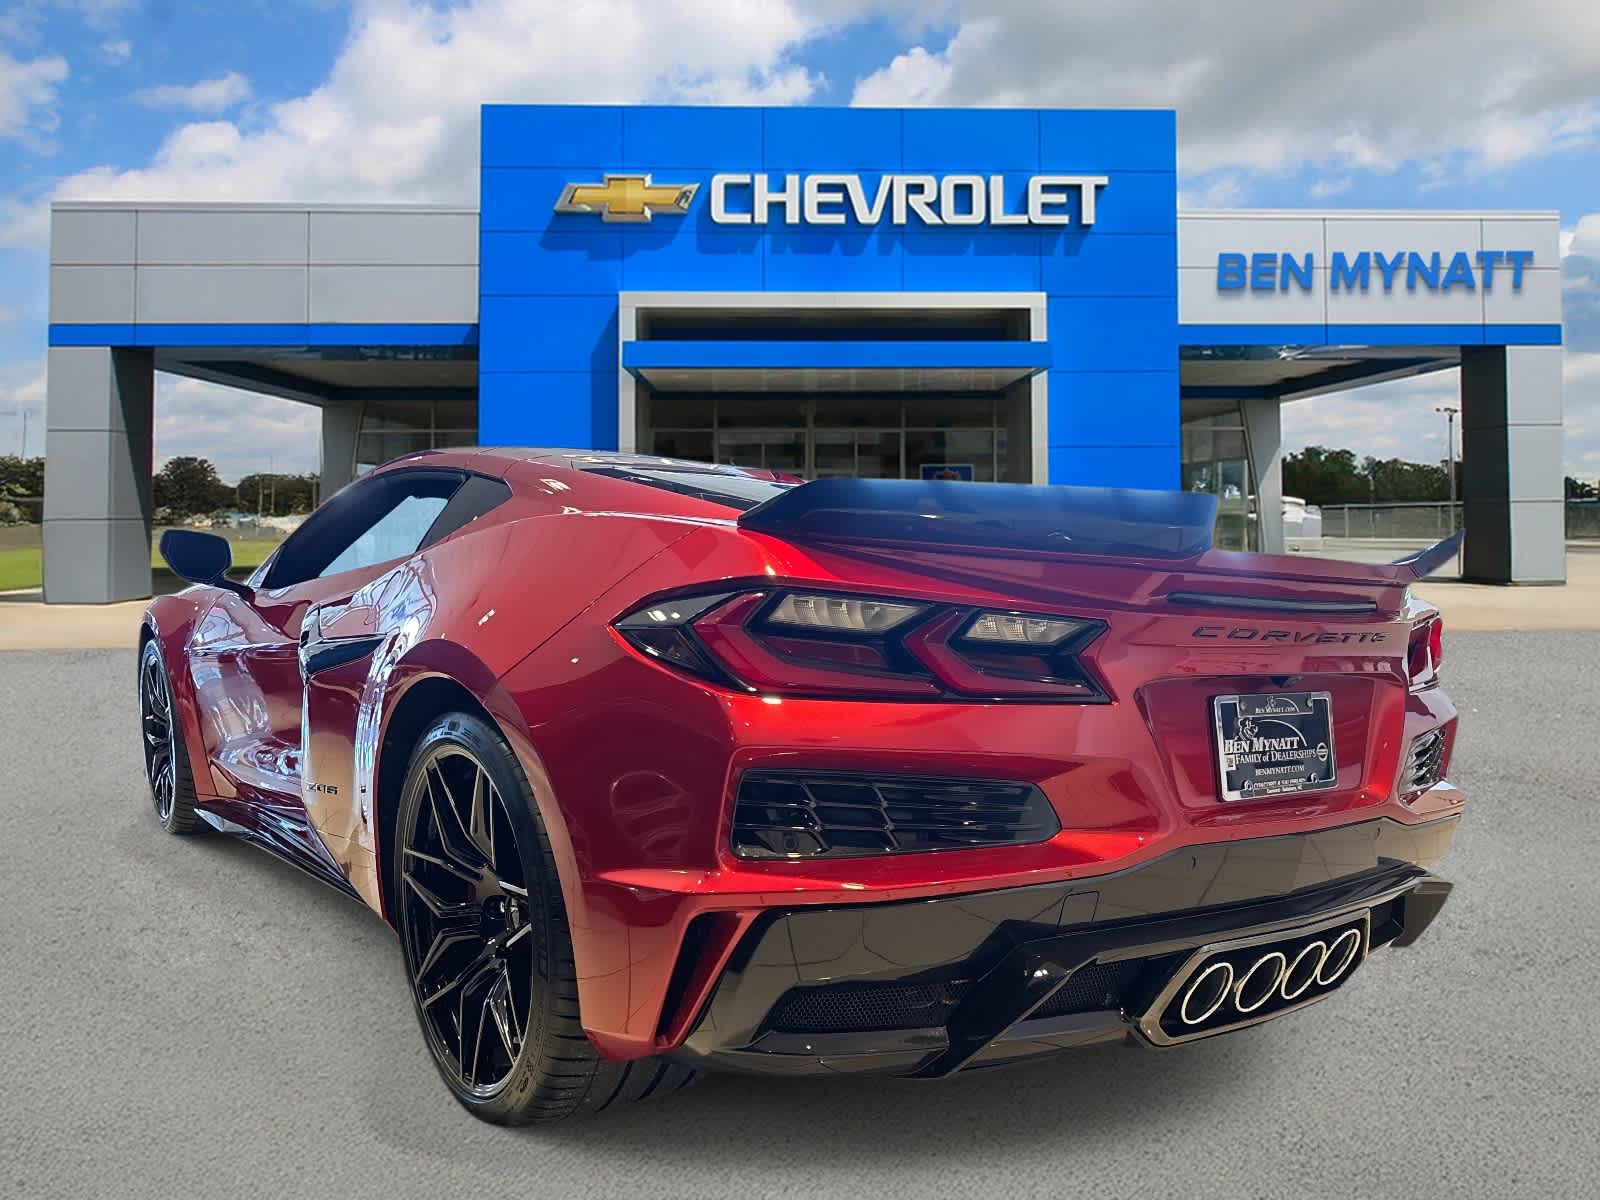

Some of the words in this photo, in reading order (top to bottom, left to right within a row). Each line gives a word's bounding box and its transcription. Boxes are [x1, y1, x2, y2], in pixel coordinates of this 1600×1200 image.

[710, 173, 1109, 225] CHEVROLET
[1217, 253, 1313, 290] BEN
[1330, 251, 1534, 290] MYNATT
[1192, 626, 1387, 643] CORVETTE
[1224, 739, 1250, 754] BEN
[1252, 737, 1300, 752] MYNATT
[1236, 753, 1262, 764] FAMILY
[1271, 749, 1316, 761] DEALERSHIPS
